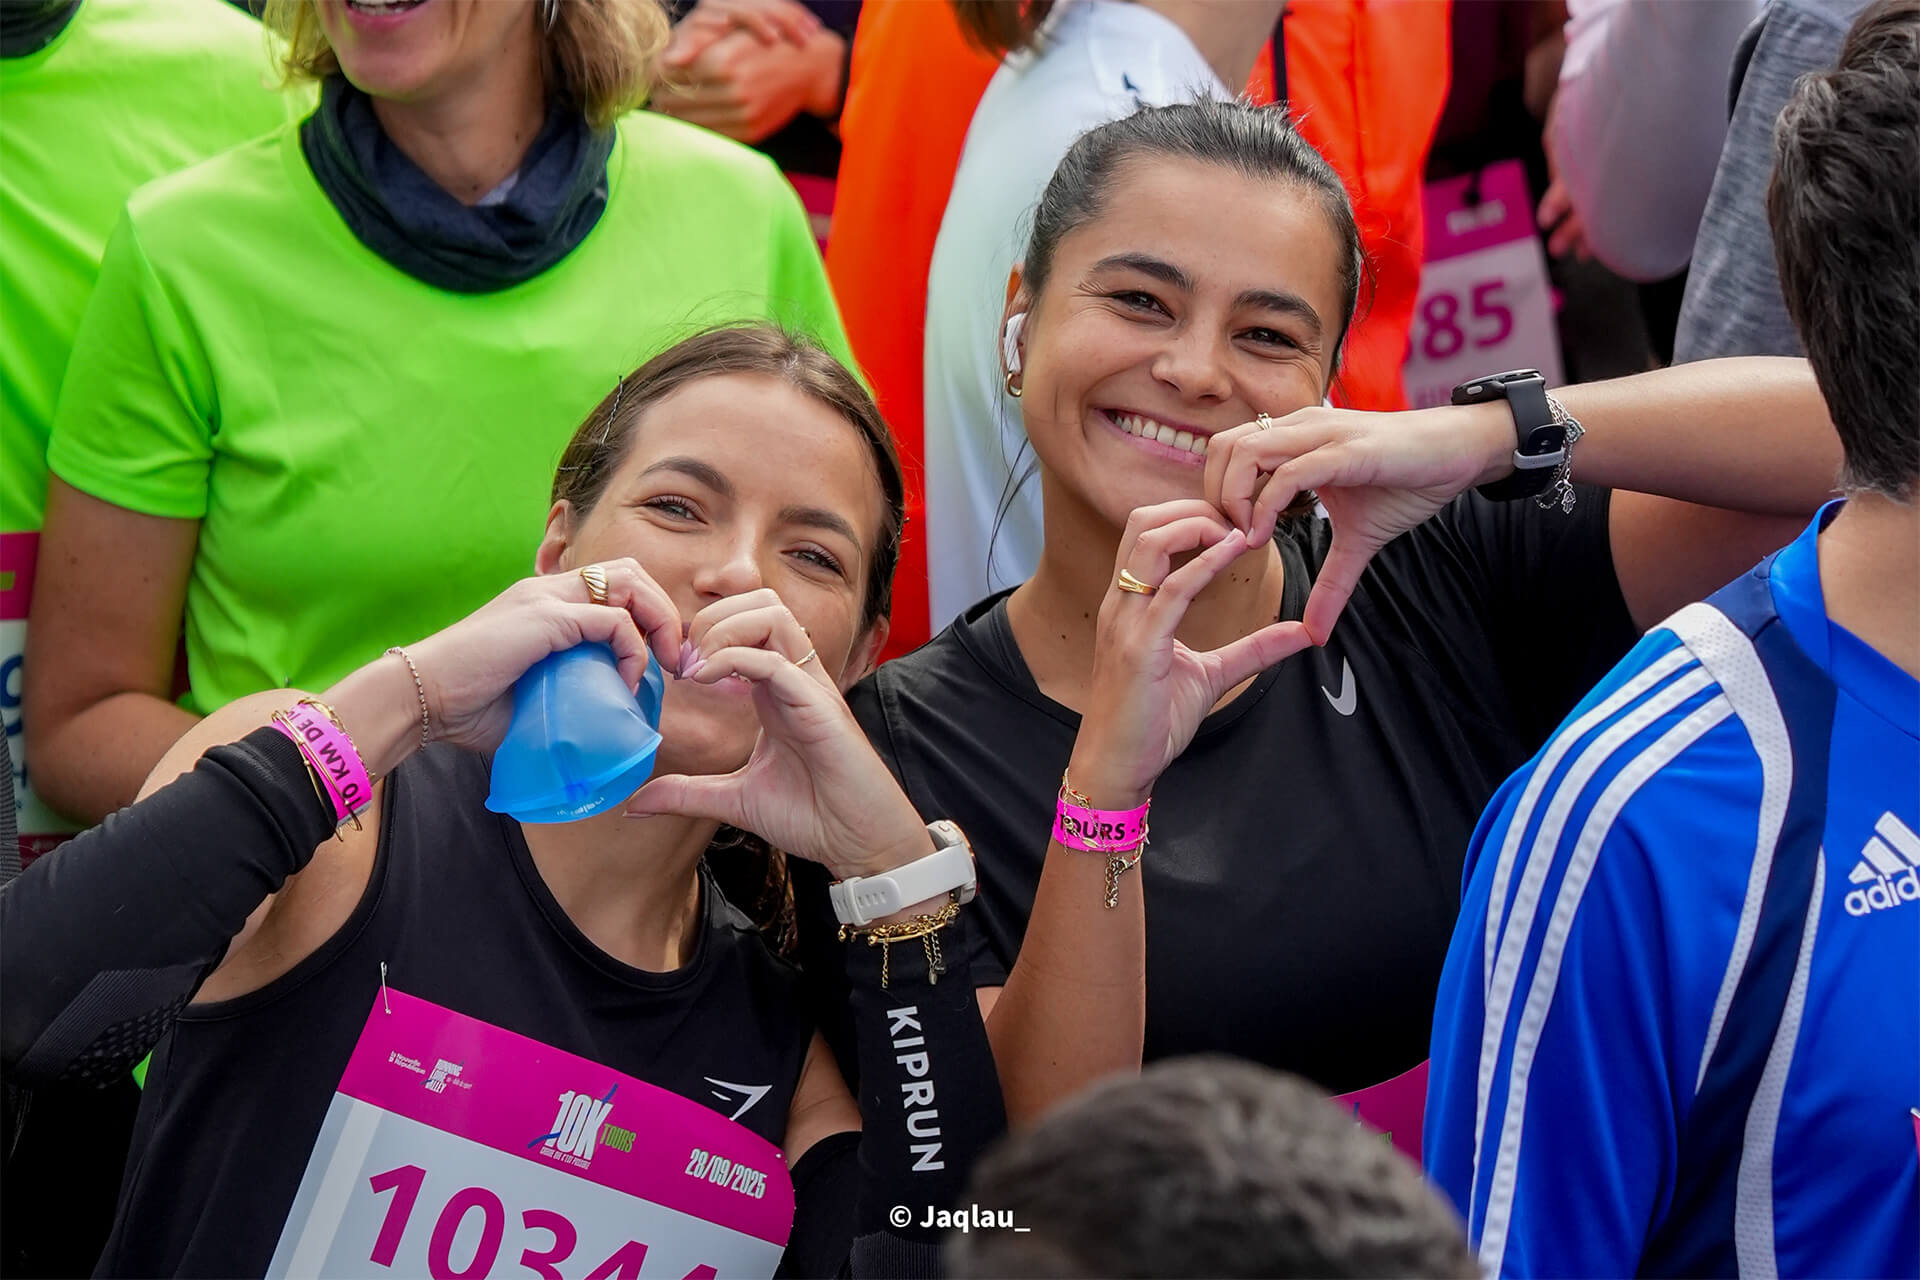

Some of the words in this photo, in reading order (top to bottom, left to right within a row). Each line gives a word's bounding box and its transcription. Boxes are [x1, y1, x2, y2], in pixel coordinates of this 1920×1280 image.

[1404, 277, 1513, 364] 85
[297, 719, 324, 743] DE
[319, 741, 351, 780] KM
[886, 1005, 945, 1172] KIPRUN
[543, 1089, 614, 1161] 10K
[600, 1122, 637, 1153] TOURS
[684, 1148, 768, 1199] 28/09/2025
[369, 1163, 718, 1280] 103
